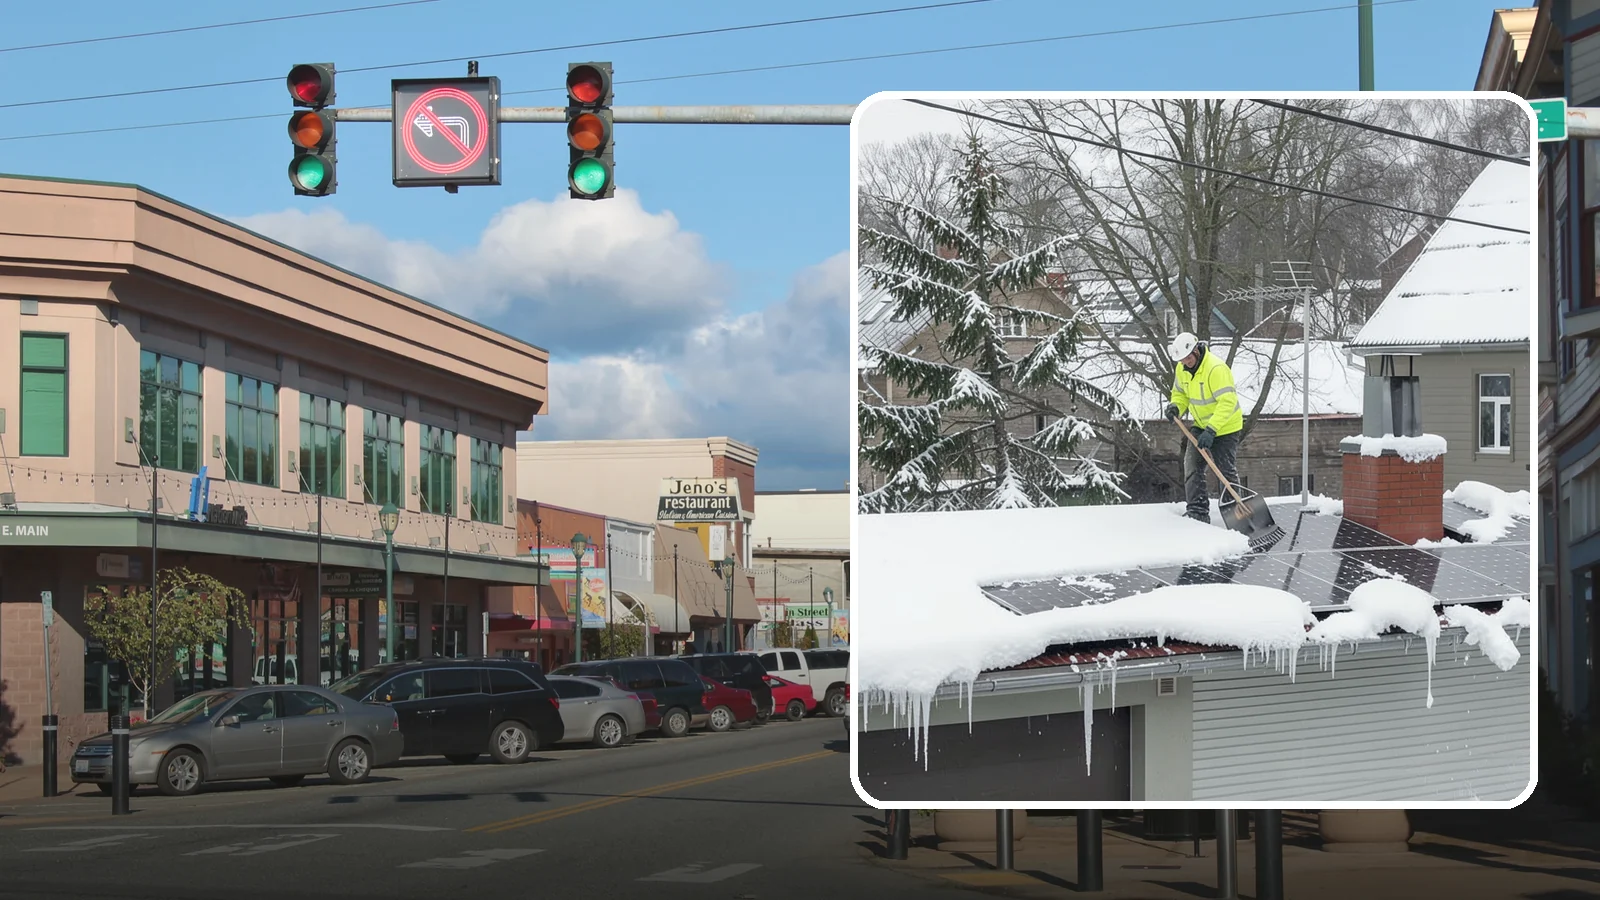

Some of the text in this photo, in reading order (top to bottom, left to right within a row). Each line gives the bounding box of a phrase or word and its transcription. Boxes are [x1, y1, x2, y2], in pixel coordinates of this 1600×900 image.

[670, 480, 727, 494] Jeno's
[665, 496, 731, 509] restaurant
[658, 510, 681, 520] Italian
[686, 510, 714, 519] American
[714, 509, 738, 519] Cuisine
[2, 525, 49, 536] E. MAIN
[797, 607, 828, 617] Street
